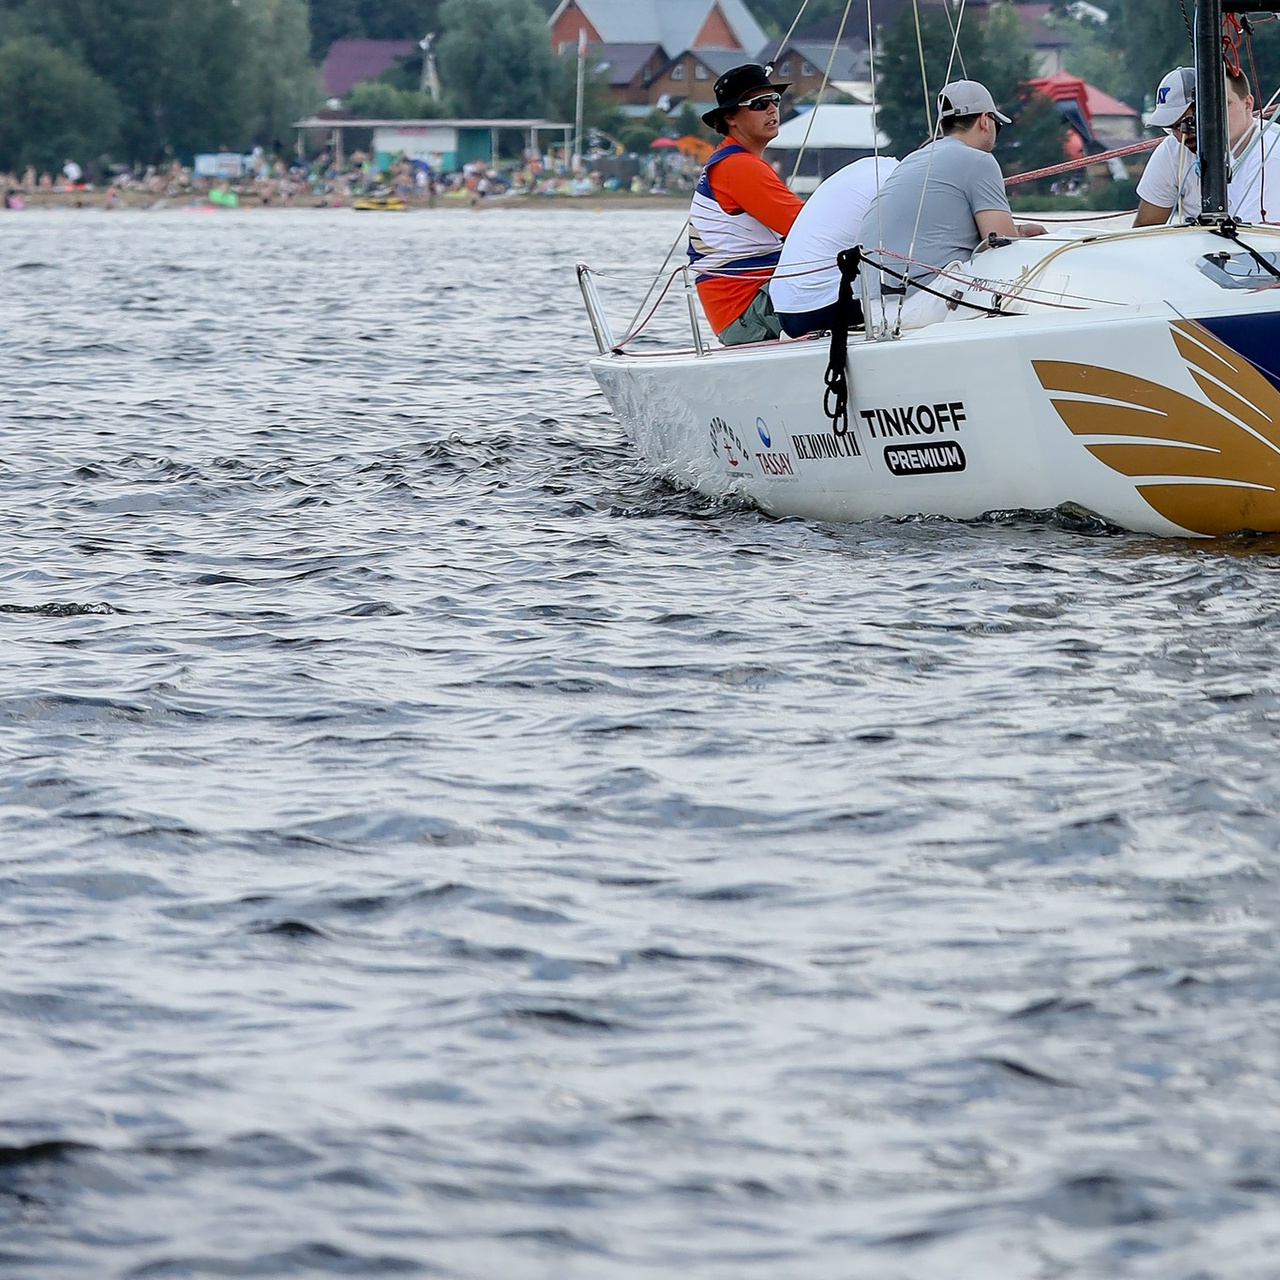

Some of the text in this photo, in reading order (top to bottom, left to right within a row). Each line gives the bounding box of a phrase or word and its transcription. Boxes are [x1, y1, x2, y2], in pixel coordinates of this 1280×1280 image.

[859, 401, 967, 439] TINKOFF
[791, 431, 862, 461] ВЕДОМОСТИ
[887, 446, 962, 471] PREMIUM
[755, 452, 795, 476] TASSAY
